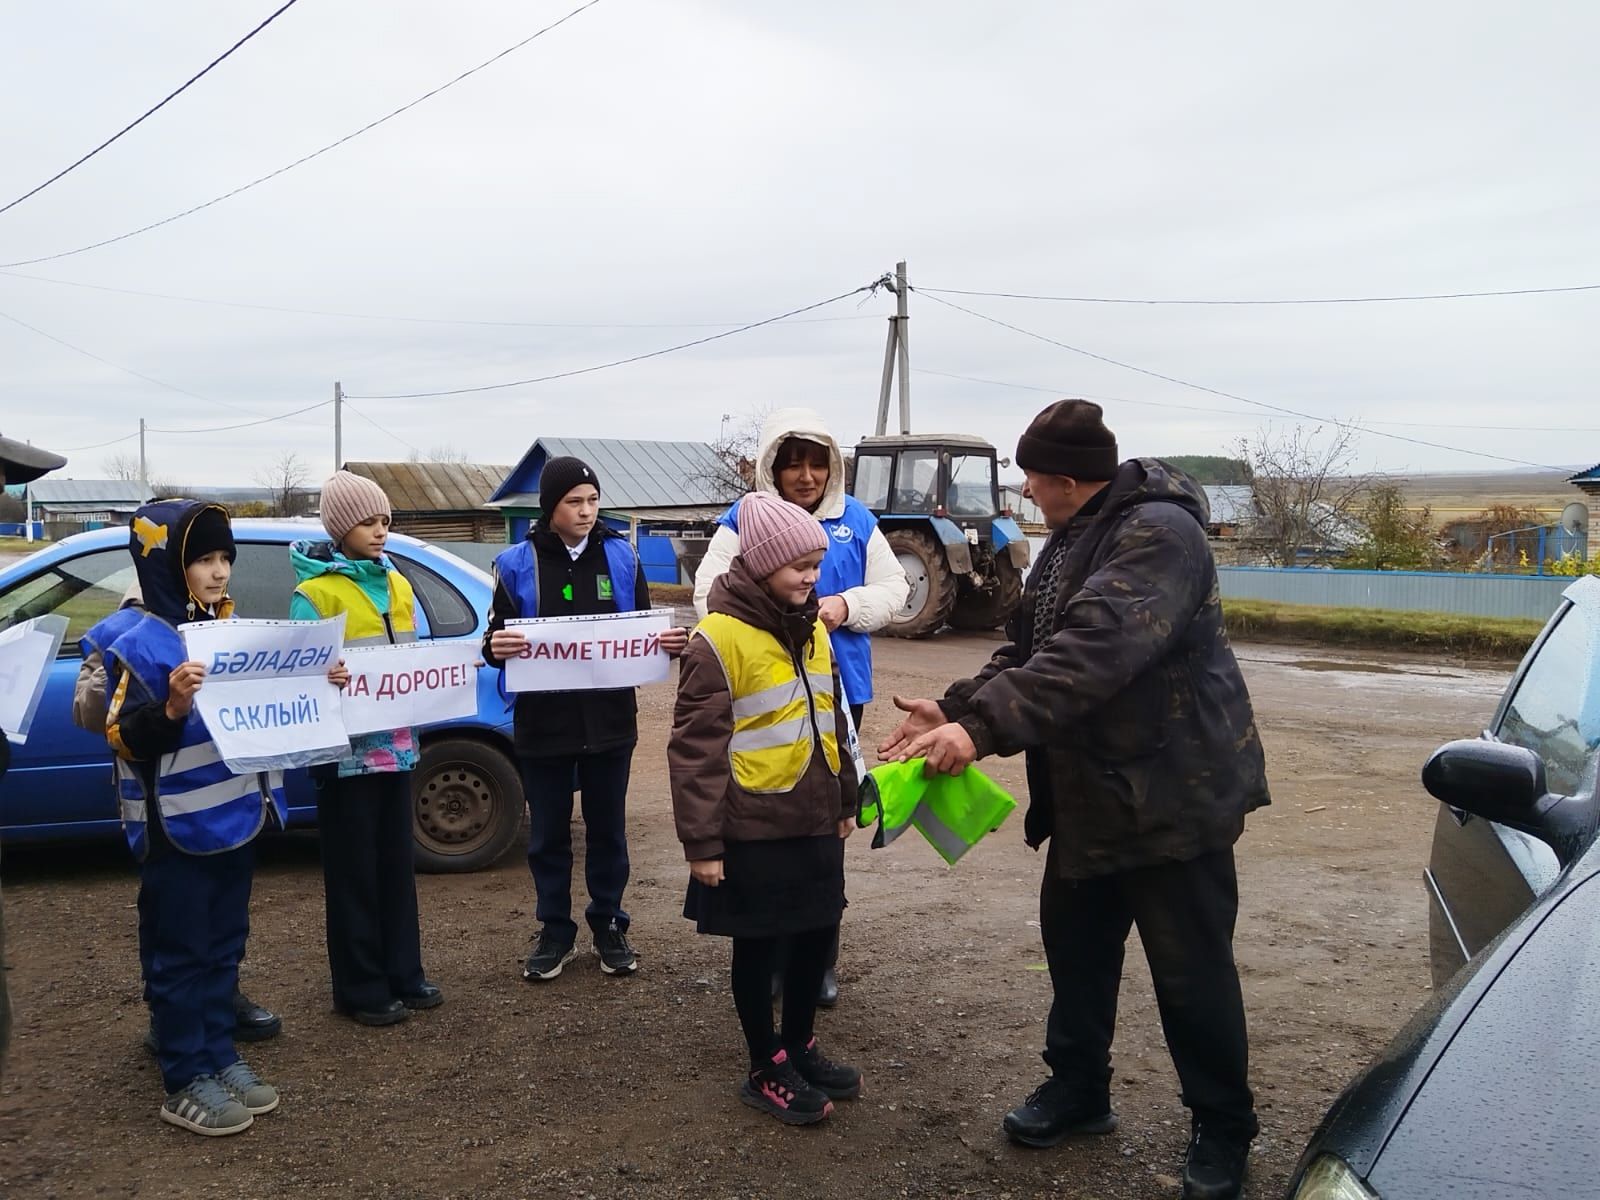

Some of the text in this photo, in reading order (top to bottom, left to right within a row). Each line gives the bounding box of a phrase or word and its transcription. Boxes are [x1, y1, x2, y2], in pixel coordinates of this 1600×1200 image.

[210, 645, 333, 675] БӘЛАДӘН
[376, 664, 467, 701] ДОРОГЕ!
[218, 694, 320, 731] САКЛЫЙ!
